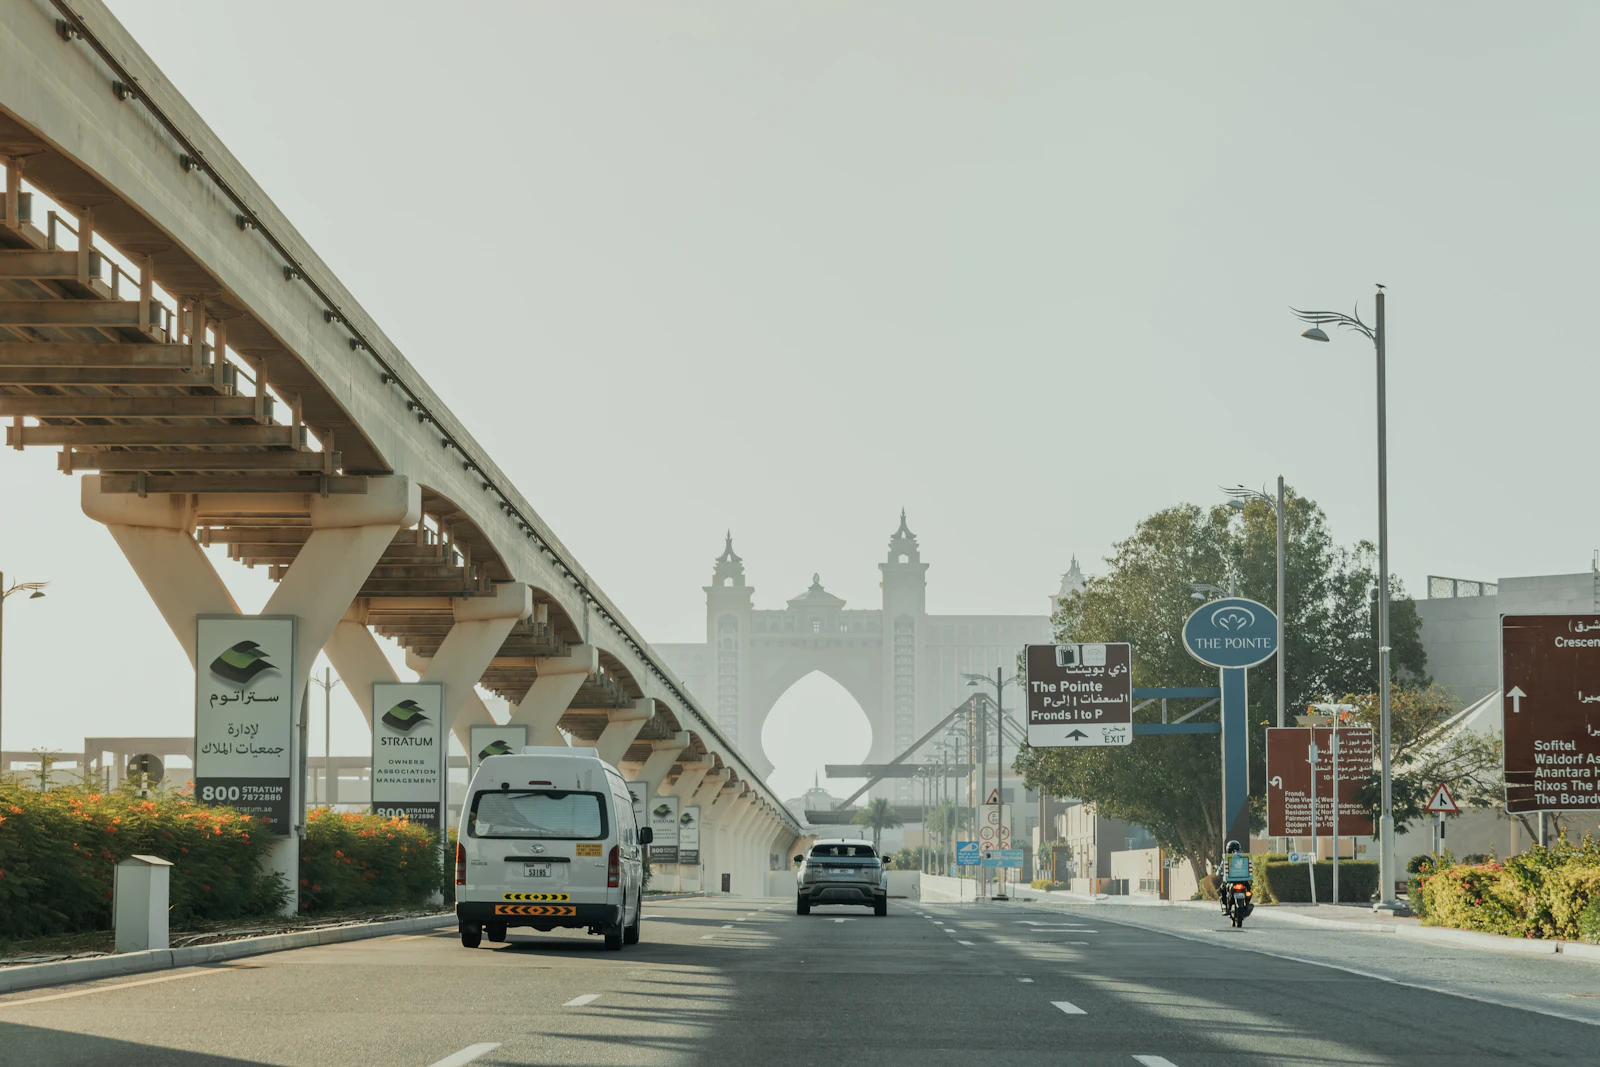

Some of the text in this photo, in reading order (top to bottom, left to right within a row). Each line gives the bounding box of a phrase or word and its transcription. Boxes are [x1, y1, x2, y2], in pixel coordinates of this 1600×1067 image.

[1195, 637, 1272, 649] THE POINTE
[1066, 663, 1127, 677] ذي بوينت
[1031, 681, 1103, 692] The Pointe
[210, 690, 279, 708] ستراتوم
[1080, 694, 1128, 704] السعفات
[1032, 710, 1072, 720] Fronds
[1081, 710, 1092, 720] to
[1095, 709, 1103, 719] P
[228, 723, 259, 738] لإدارة
[381, 737, 432, 746] STRATUM
[1534, 740, 1576, 750] Sofitel
[202, 742, 284, 758] جمعيات الملاك
[1534, 753, 1583, 764] Waldorf
[1534, 766, 1590, 778] Anantara
[1534, 780, 1593, 790] Rixos The
[202, 786, 240, 800] 800
[1534, 793, 1600, 804] The Board
[377, 808, 404, 819] 800
